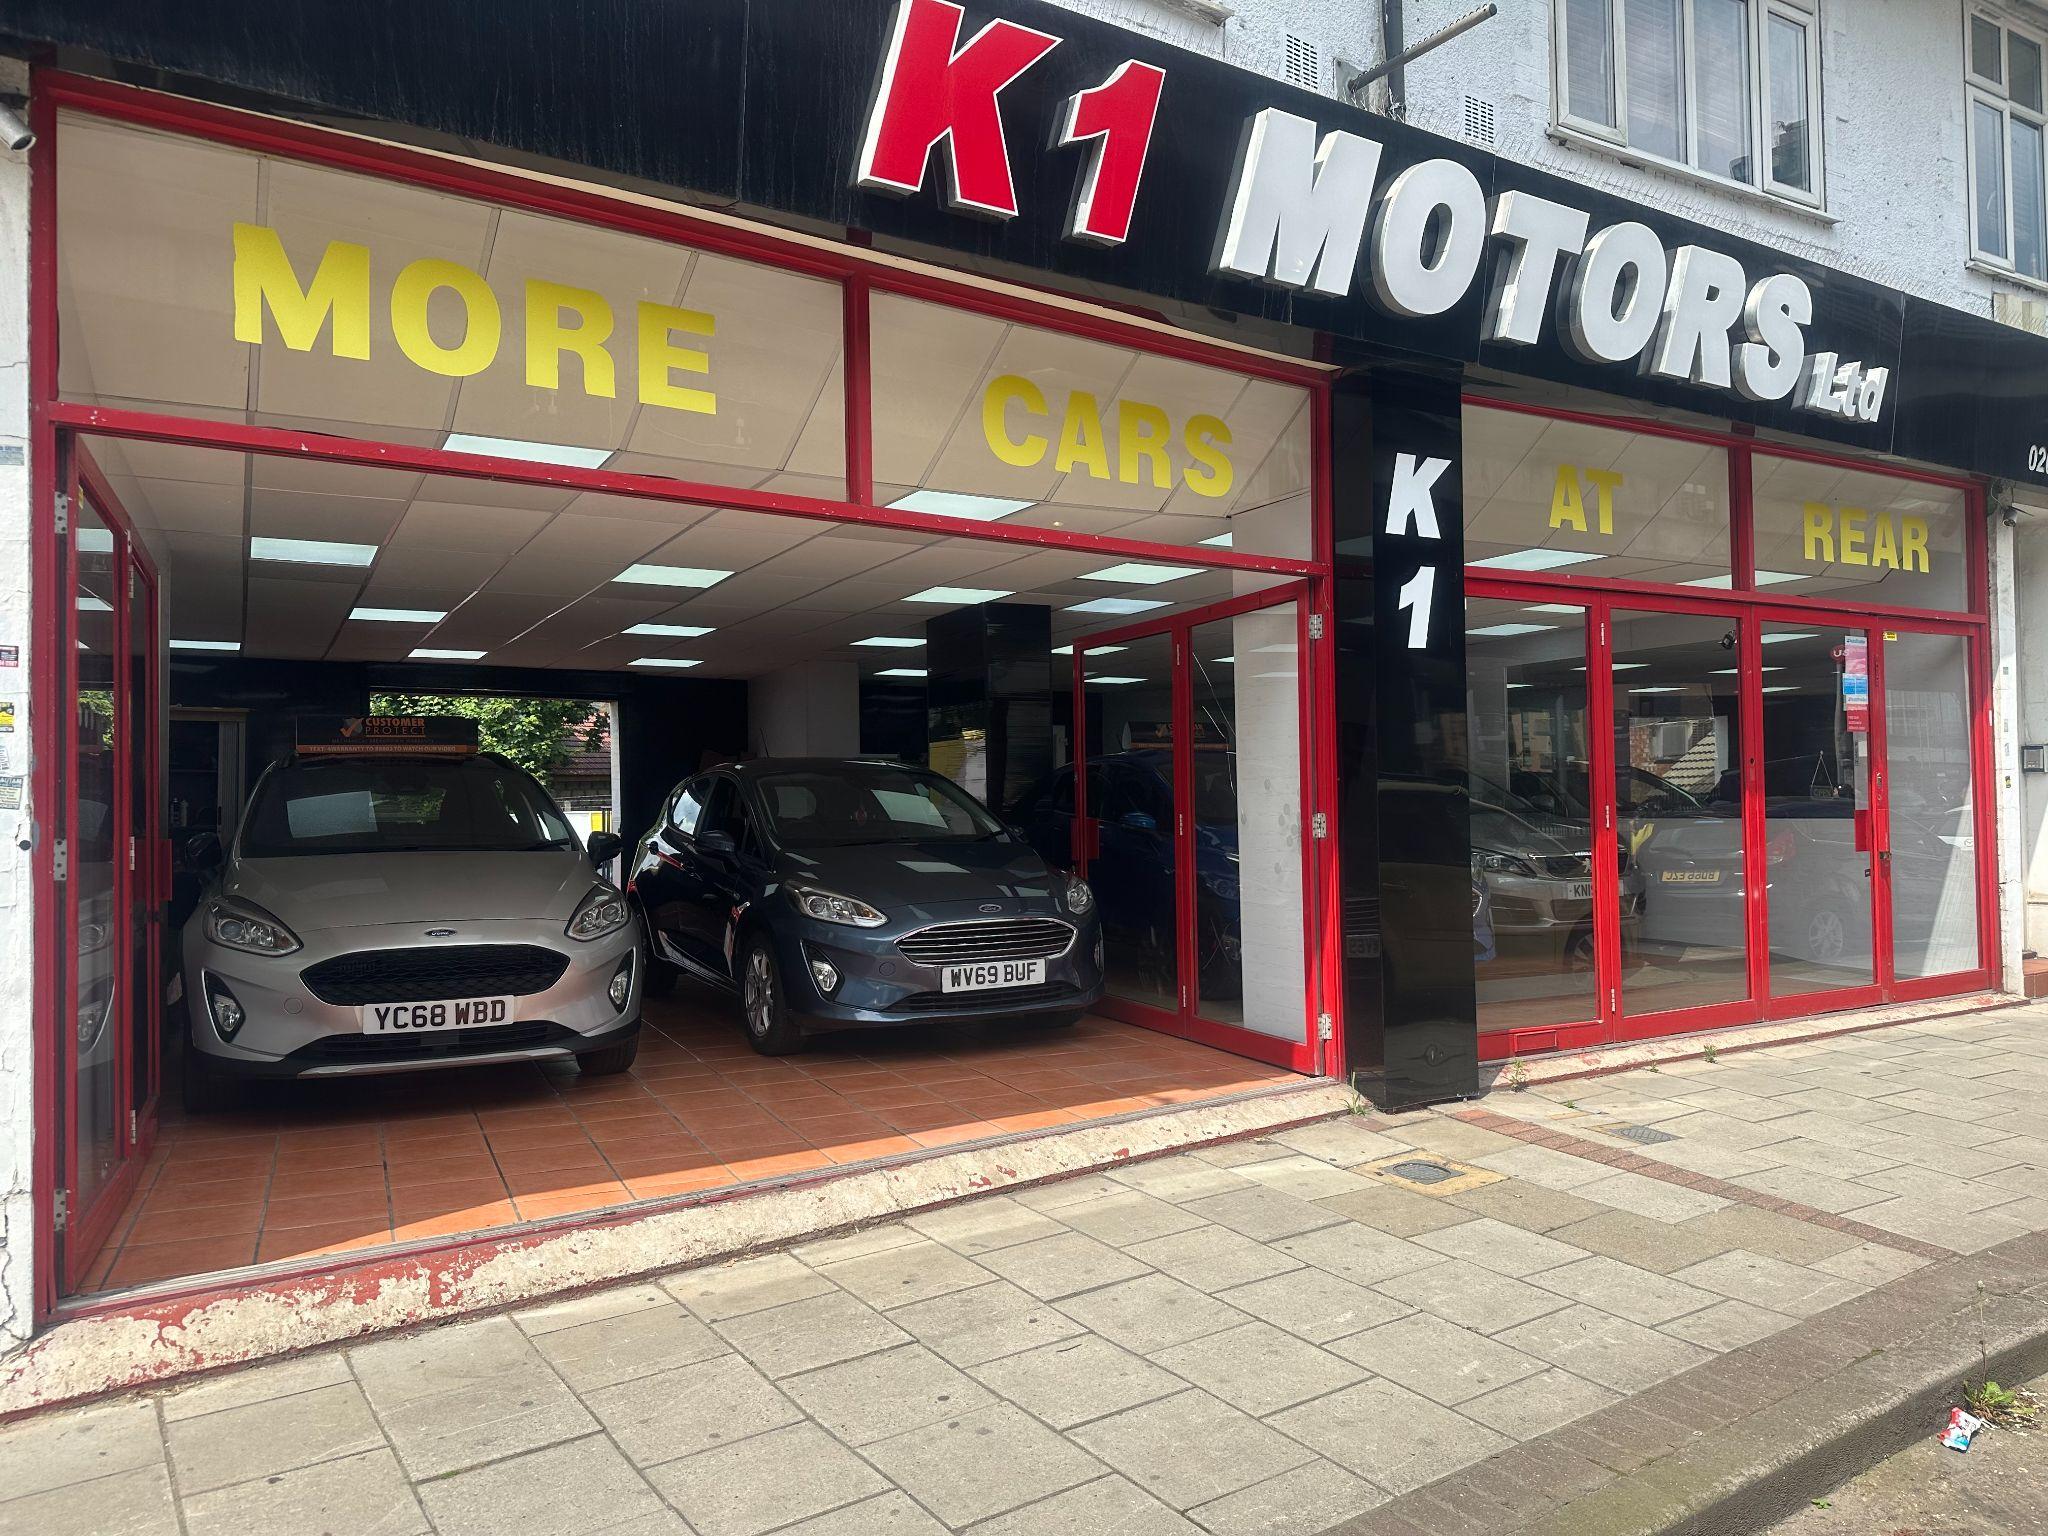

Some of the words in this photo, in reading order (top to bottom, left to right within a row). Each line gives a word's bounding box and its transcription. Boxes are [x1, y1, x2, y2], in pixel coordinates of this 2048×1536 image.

[856, 0, 1166, 244] K1
[1217, 106, 1813, 402] MOTORS
[1809, 351, 1890, 424] Ltd
[233, 222, 717, 415] MORE
[982, 374, 1235, 498] CARS
[1548, 463, 1624, 535] AT
[1803, 500, 1930, 574] REAR
[365, 717, 426, 727] CUSTOMER
[365, 726, 426, 735] PROTECT
[1573, 883, 1593, 898] KN1
[950, 965, 999, 988] WV69
[1003, 961, 1037, 983] BUF
[374, 1004, 446, 1030] YC68
[454, 999, 506, 1026] WBD
